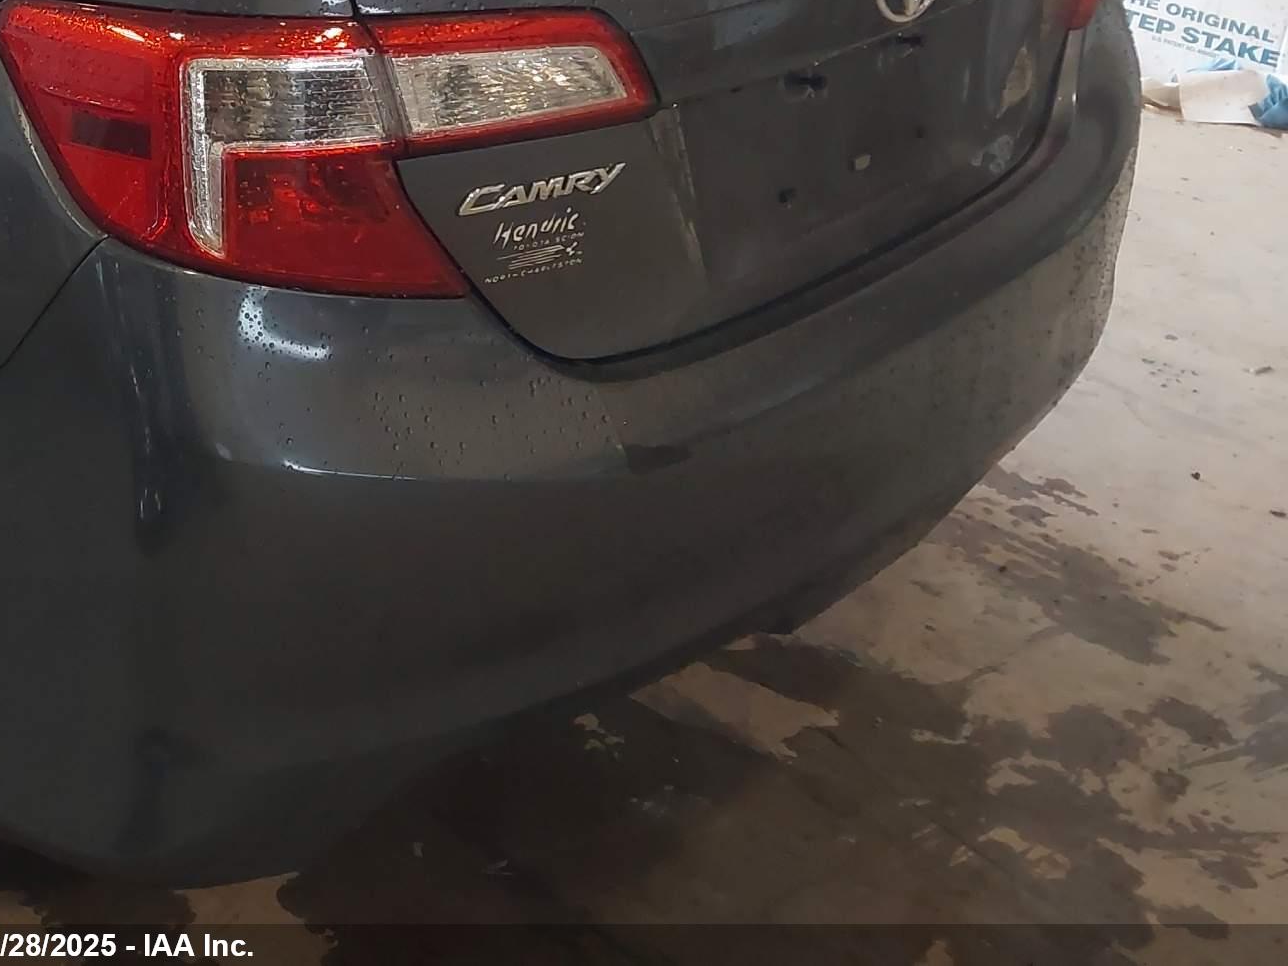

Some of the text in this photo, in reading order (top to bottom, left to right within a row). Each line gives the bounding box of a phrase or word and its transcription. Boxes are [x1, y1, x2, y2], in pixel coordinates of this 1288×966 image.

[1125, 9, 1280, 68] TEP STAKE
[1166, 3, 1275, 43] ORIGINAL
[458, 162, 626, 216] CAMRY
